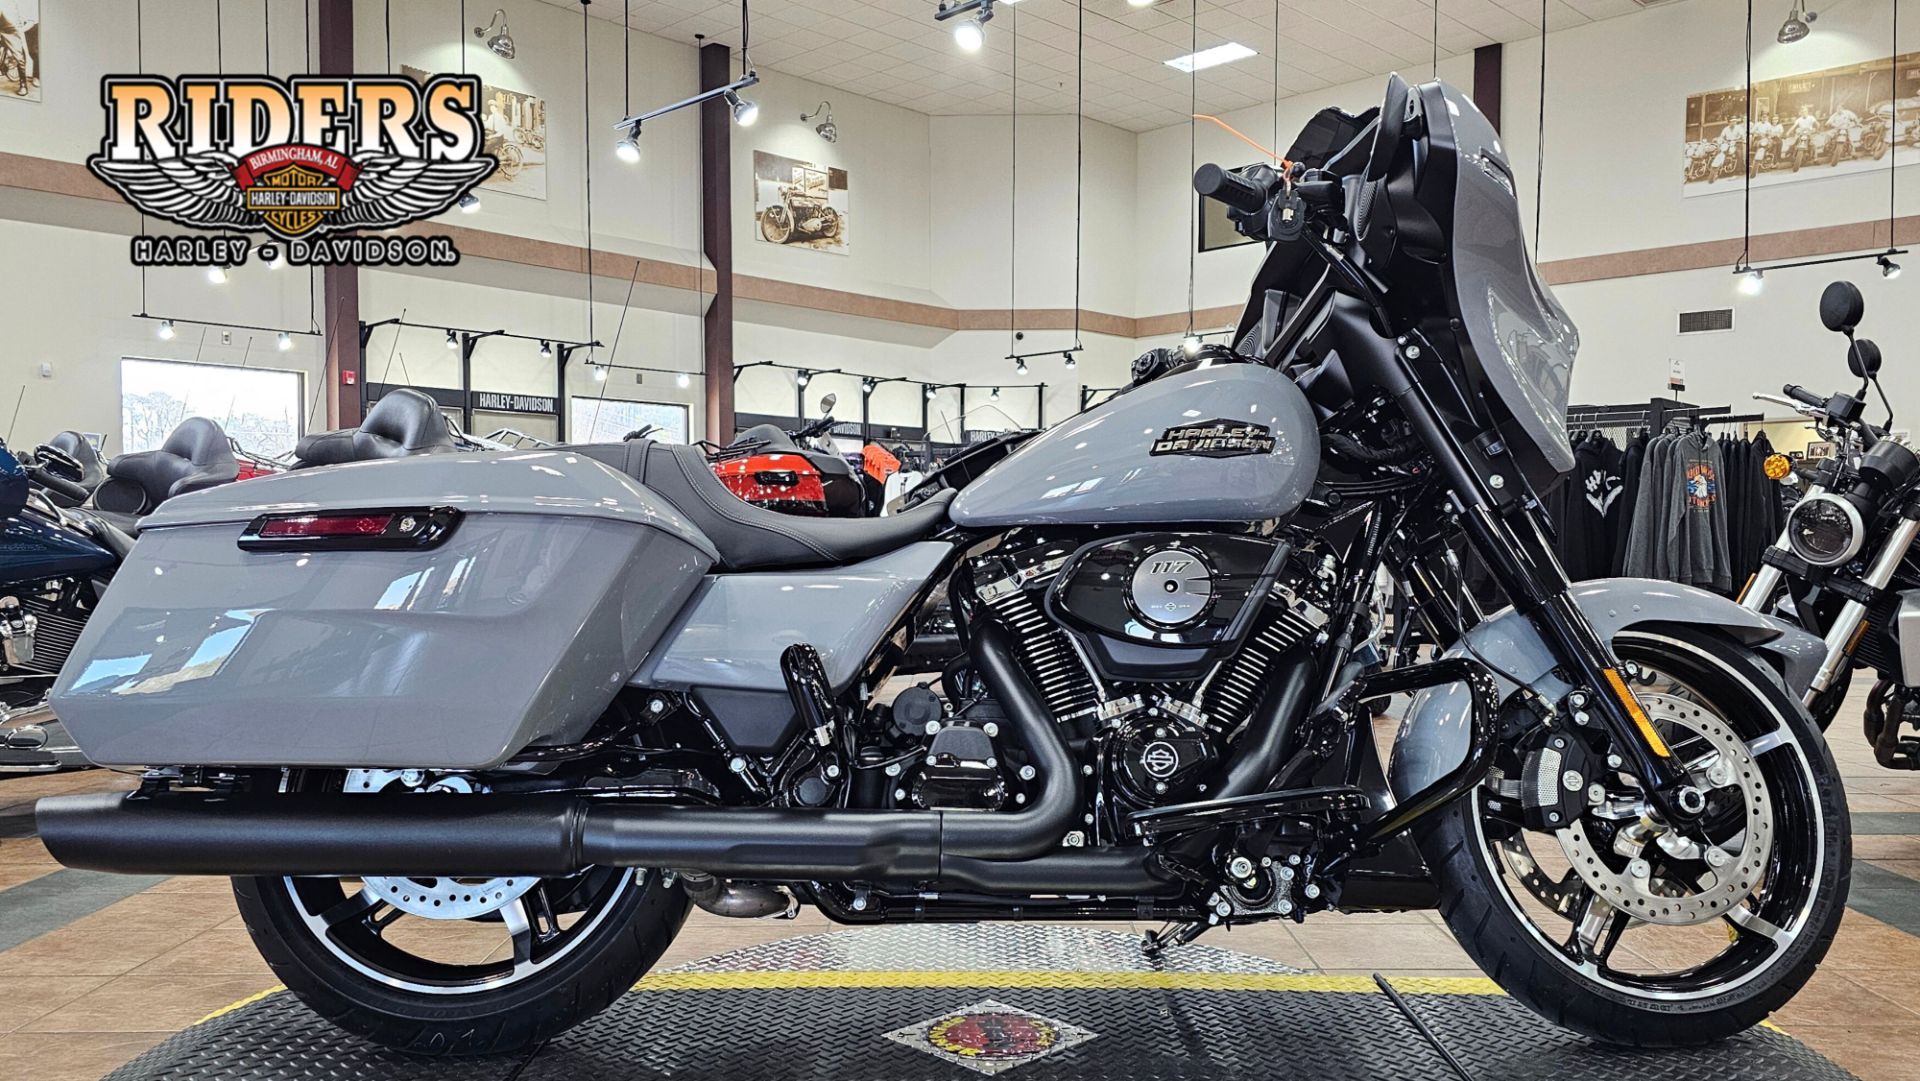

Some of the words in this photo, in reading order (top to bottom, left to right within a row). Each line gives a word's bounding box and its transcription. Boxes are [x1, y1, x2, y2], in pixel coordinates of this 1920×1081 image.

[479, 393, 554, 412] HARLEY-DAVIDSON
[1155, 438, 1272, 452] DAVIDSON
[1150, 560, 1194, 574] 117
